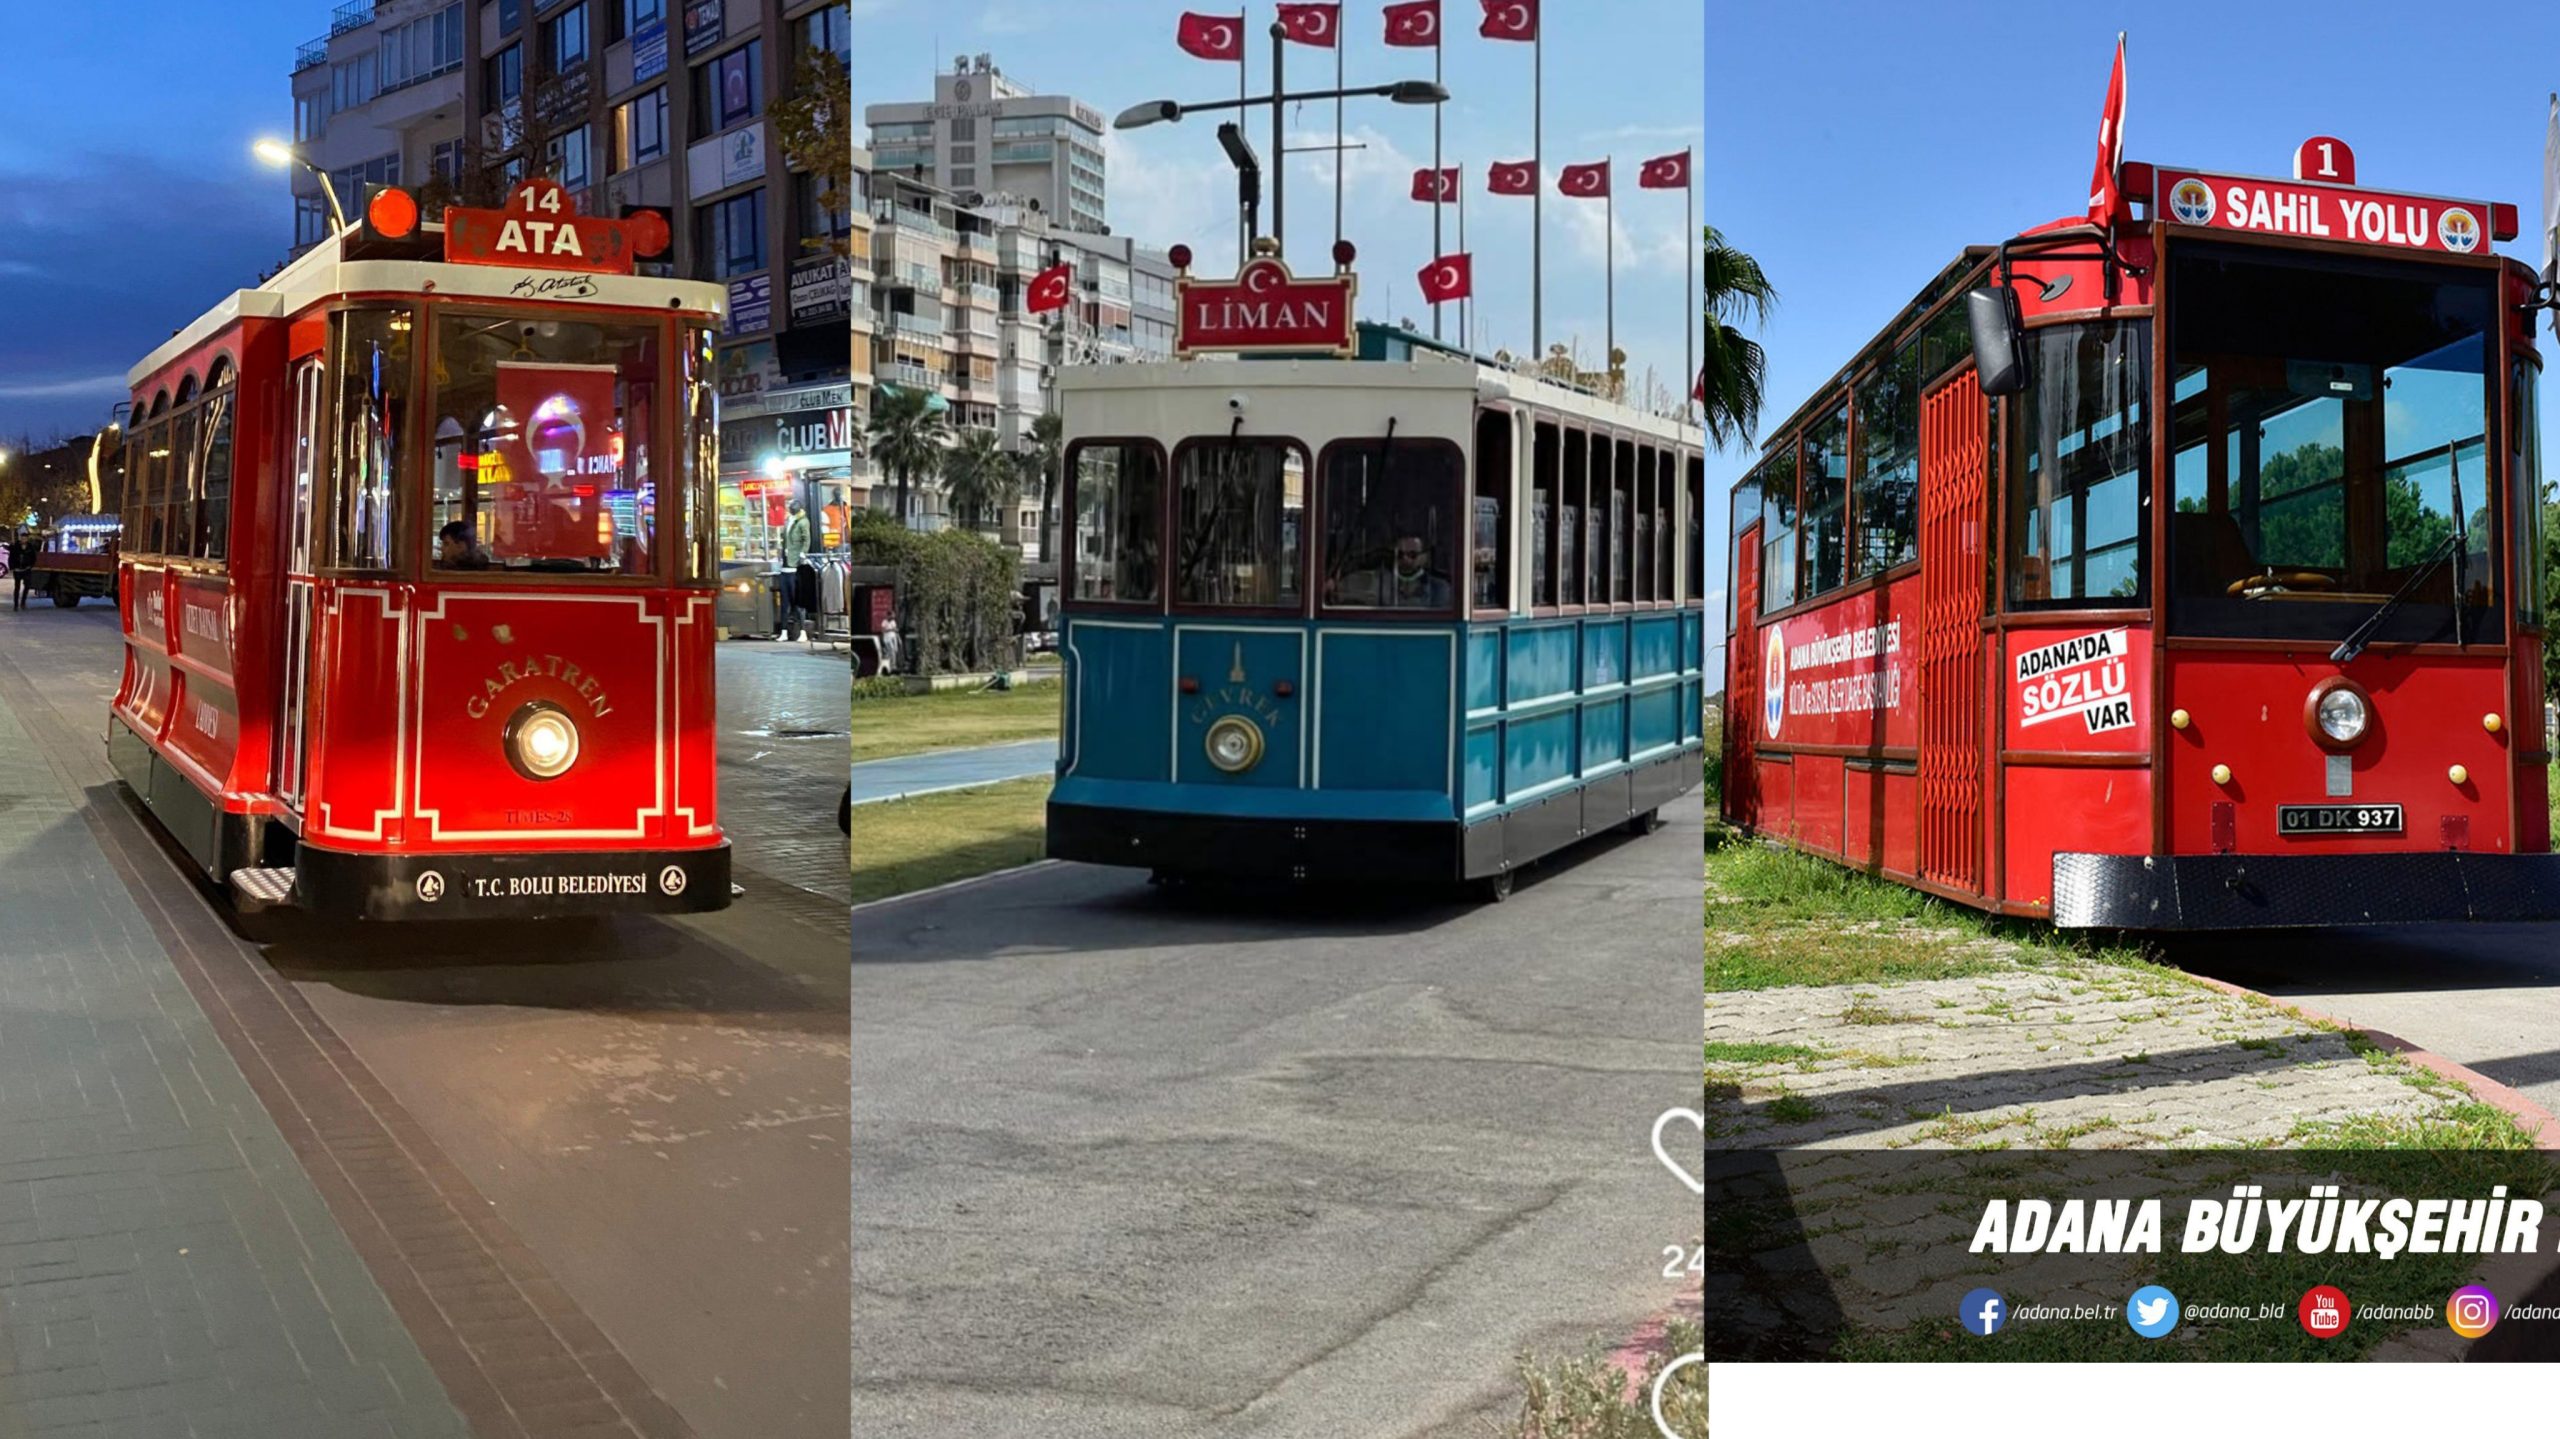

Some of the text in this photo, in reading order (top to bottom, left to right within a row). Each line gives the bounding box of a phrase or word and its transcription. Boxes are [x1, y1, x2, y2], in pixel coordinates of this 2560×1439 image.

[2317, 143, 2339, 177] 1
[519, 186, 561, 214] 14
[496, 219, 583, 257] ATA
[2339, 199, 2429, 247] YOLU
[791, 264, 834, 289] AVUKAT
[1198, 297, 1330, 330] LİMAN
[467, 654, 614, 719] GARATREN
[2023, 657, 2126, 717] SÖZLÜ
[2087, 701, 2131, 731] VAR
[2286, 809, 2396, 827] 01 DK 937
[475, 872, 647, 897] T.C. BOLU BELEDİYESİ
